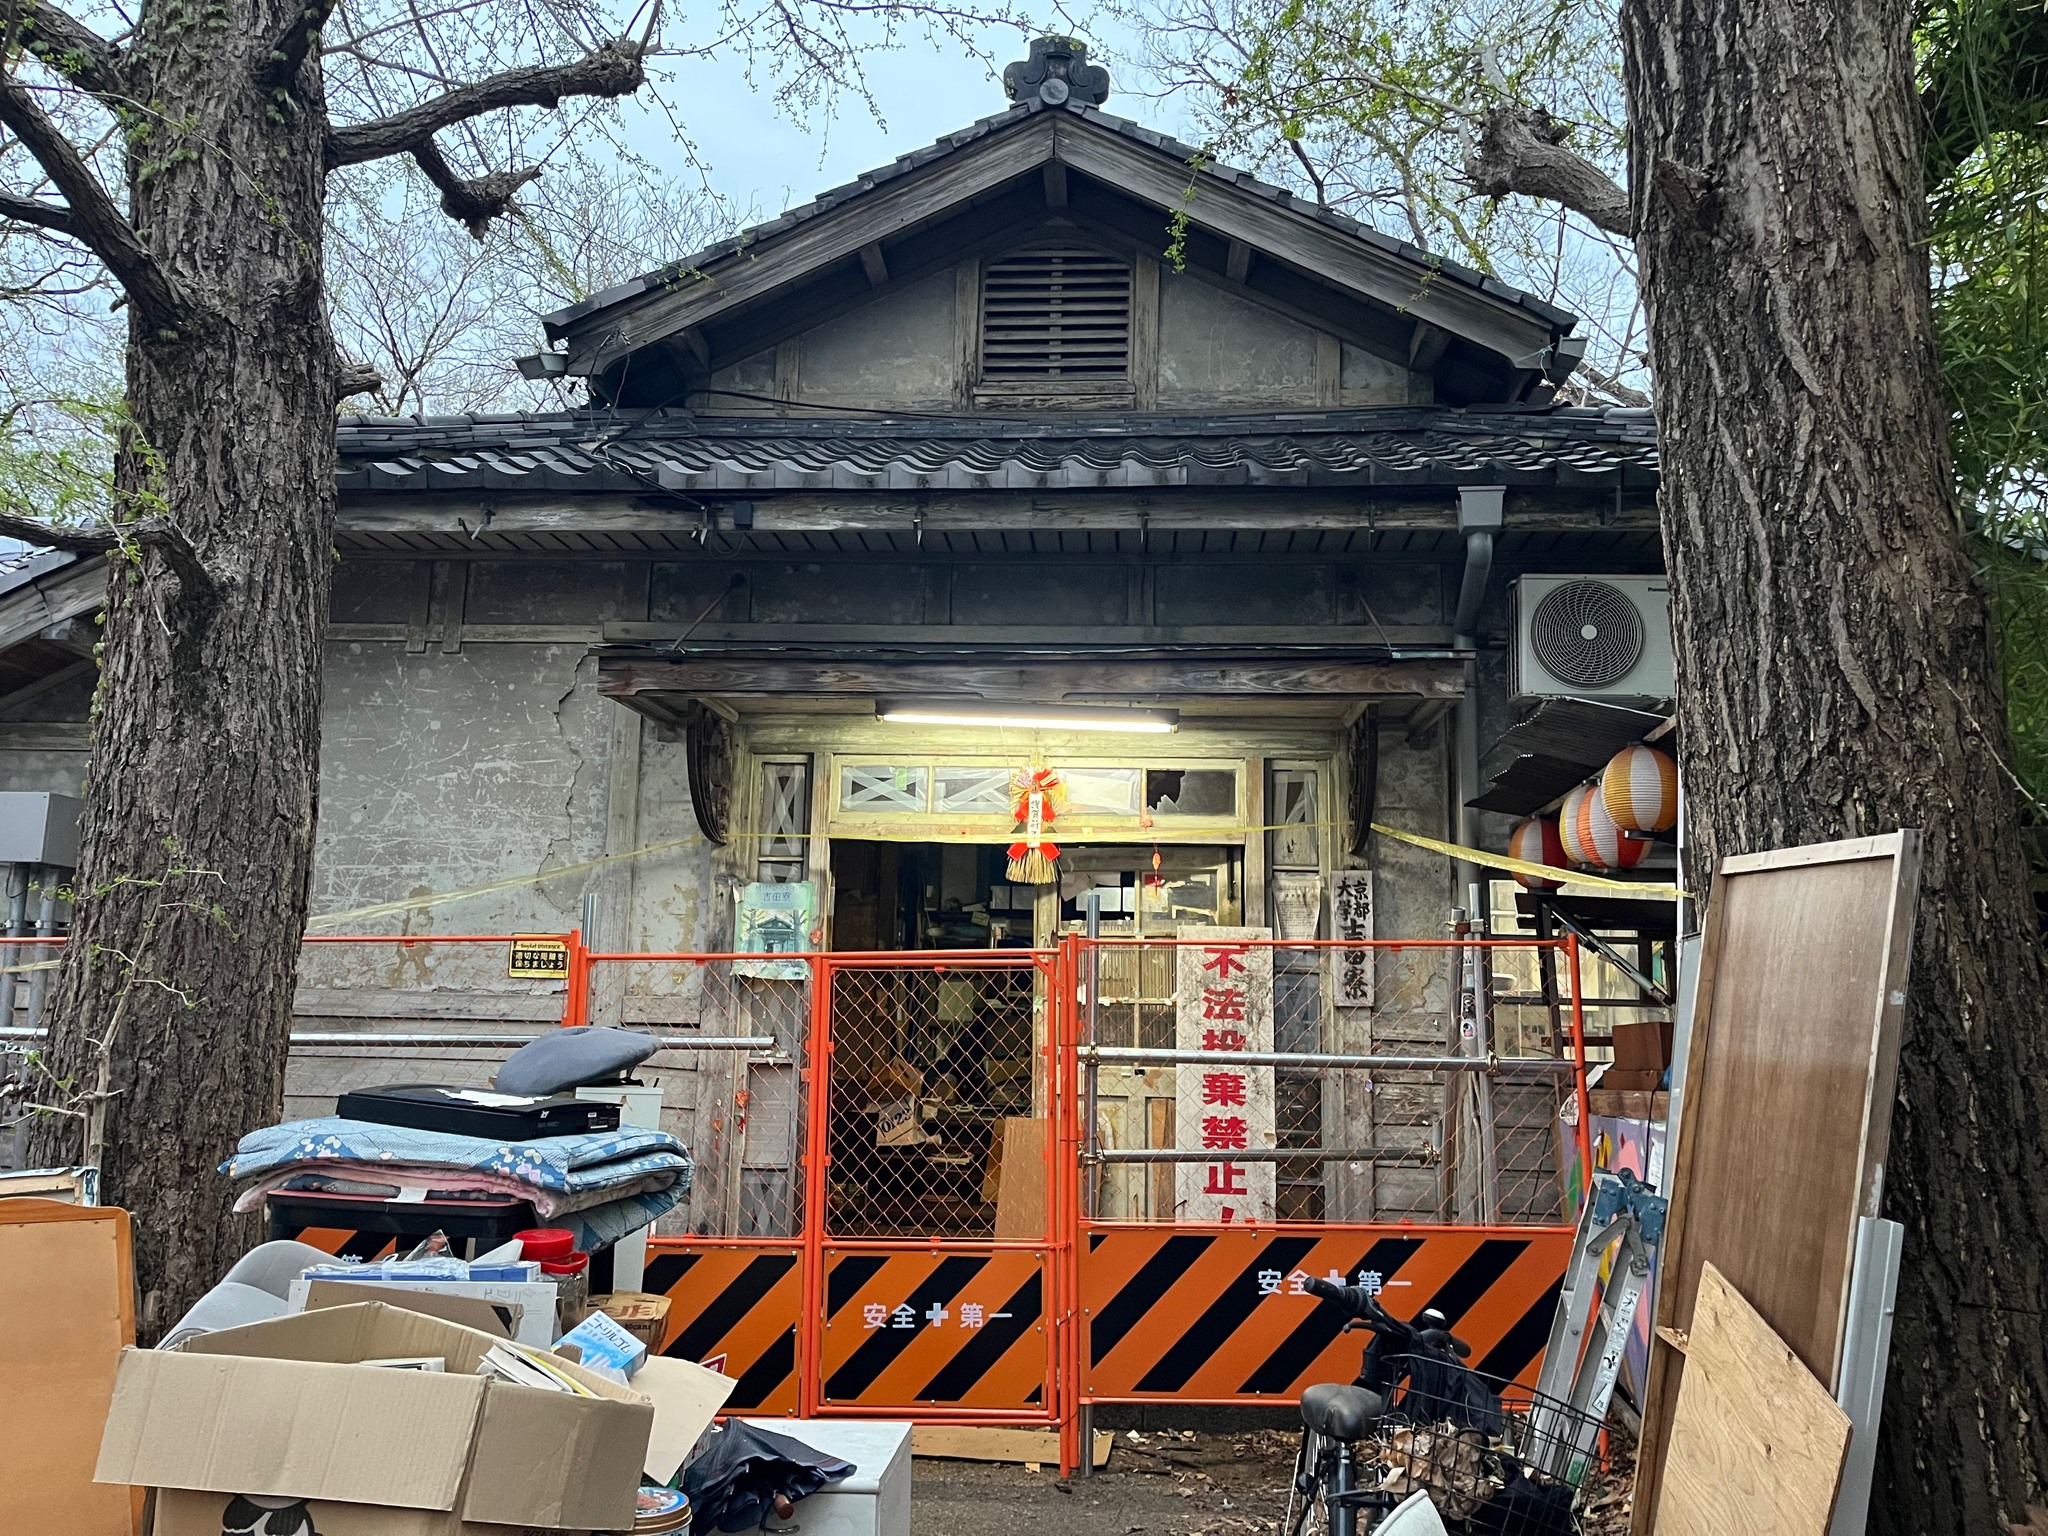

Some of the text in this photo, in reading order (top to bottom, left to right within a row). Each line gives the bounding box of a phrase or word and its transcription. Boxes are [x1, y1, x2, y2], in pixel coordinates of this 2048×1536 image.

[863, 1303, 1013, 1329] 安全 第一
[587, 1317, 631, 1354] ニトリルゴム
